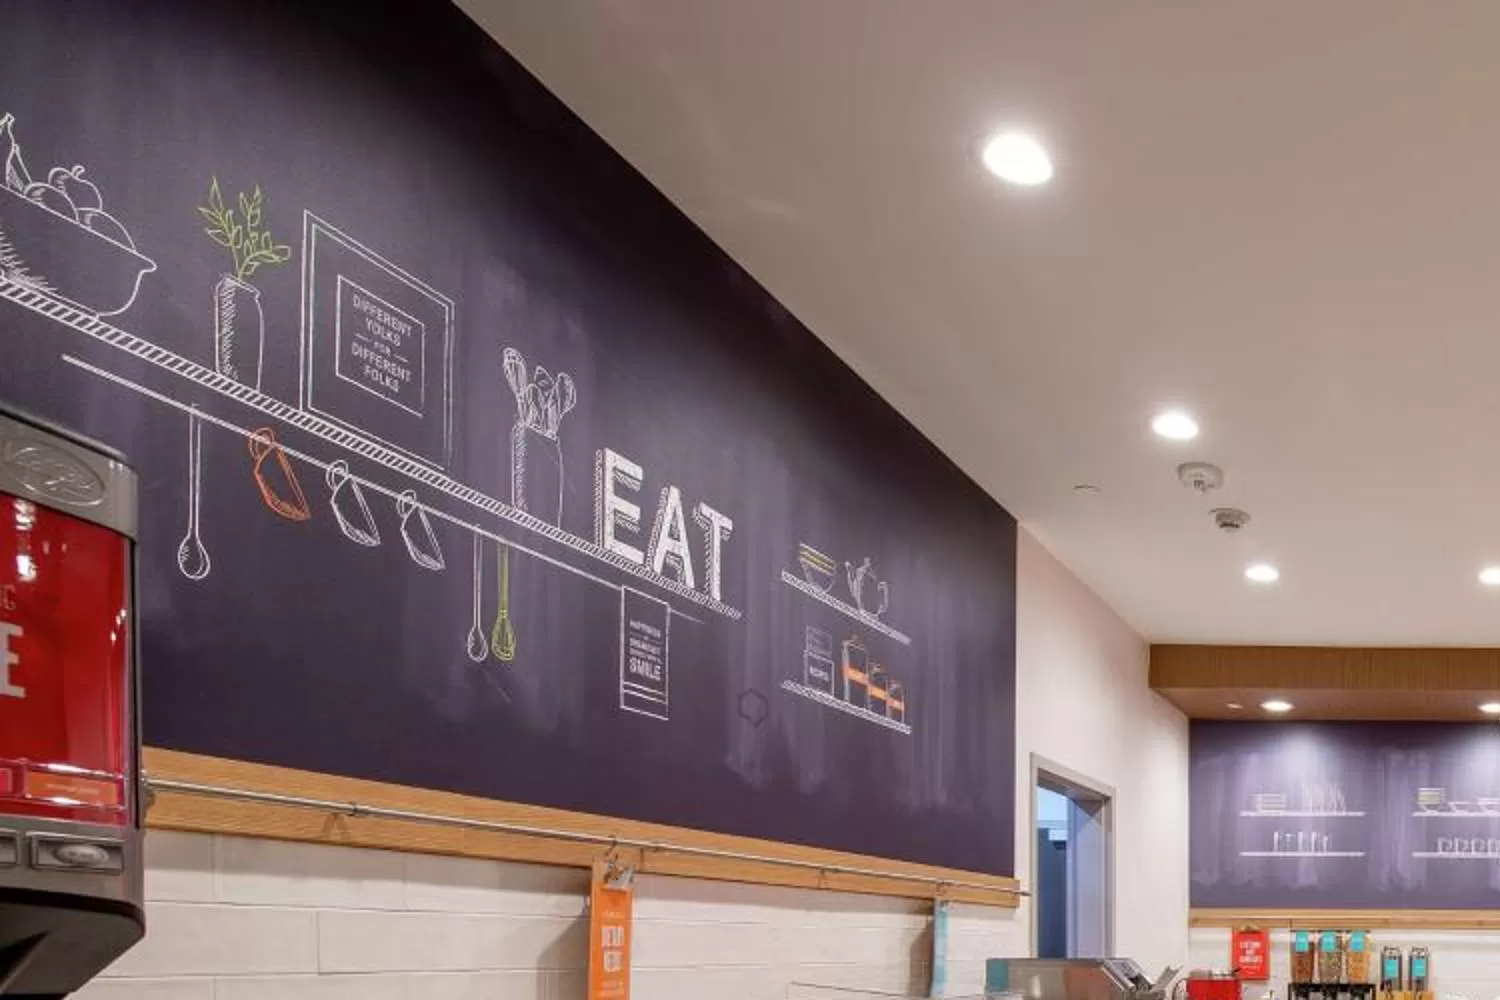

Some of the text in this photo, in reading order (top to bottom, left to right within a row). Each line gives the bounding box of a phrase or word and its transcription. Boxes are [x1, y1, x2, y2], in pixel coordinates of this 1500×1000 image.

[352, 293, 411, 337] DIFFERENT
[365, 317, 400, 347] YOLKS
[352, 341, 412, 382] DIFFERENT
[364, 364, 400, 393] FOLKS
[594, 447, 733, 601] EAT
[629, 657, 661, 681] SMILE
